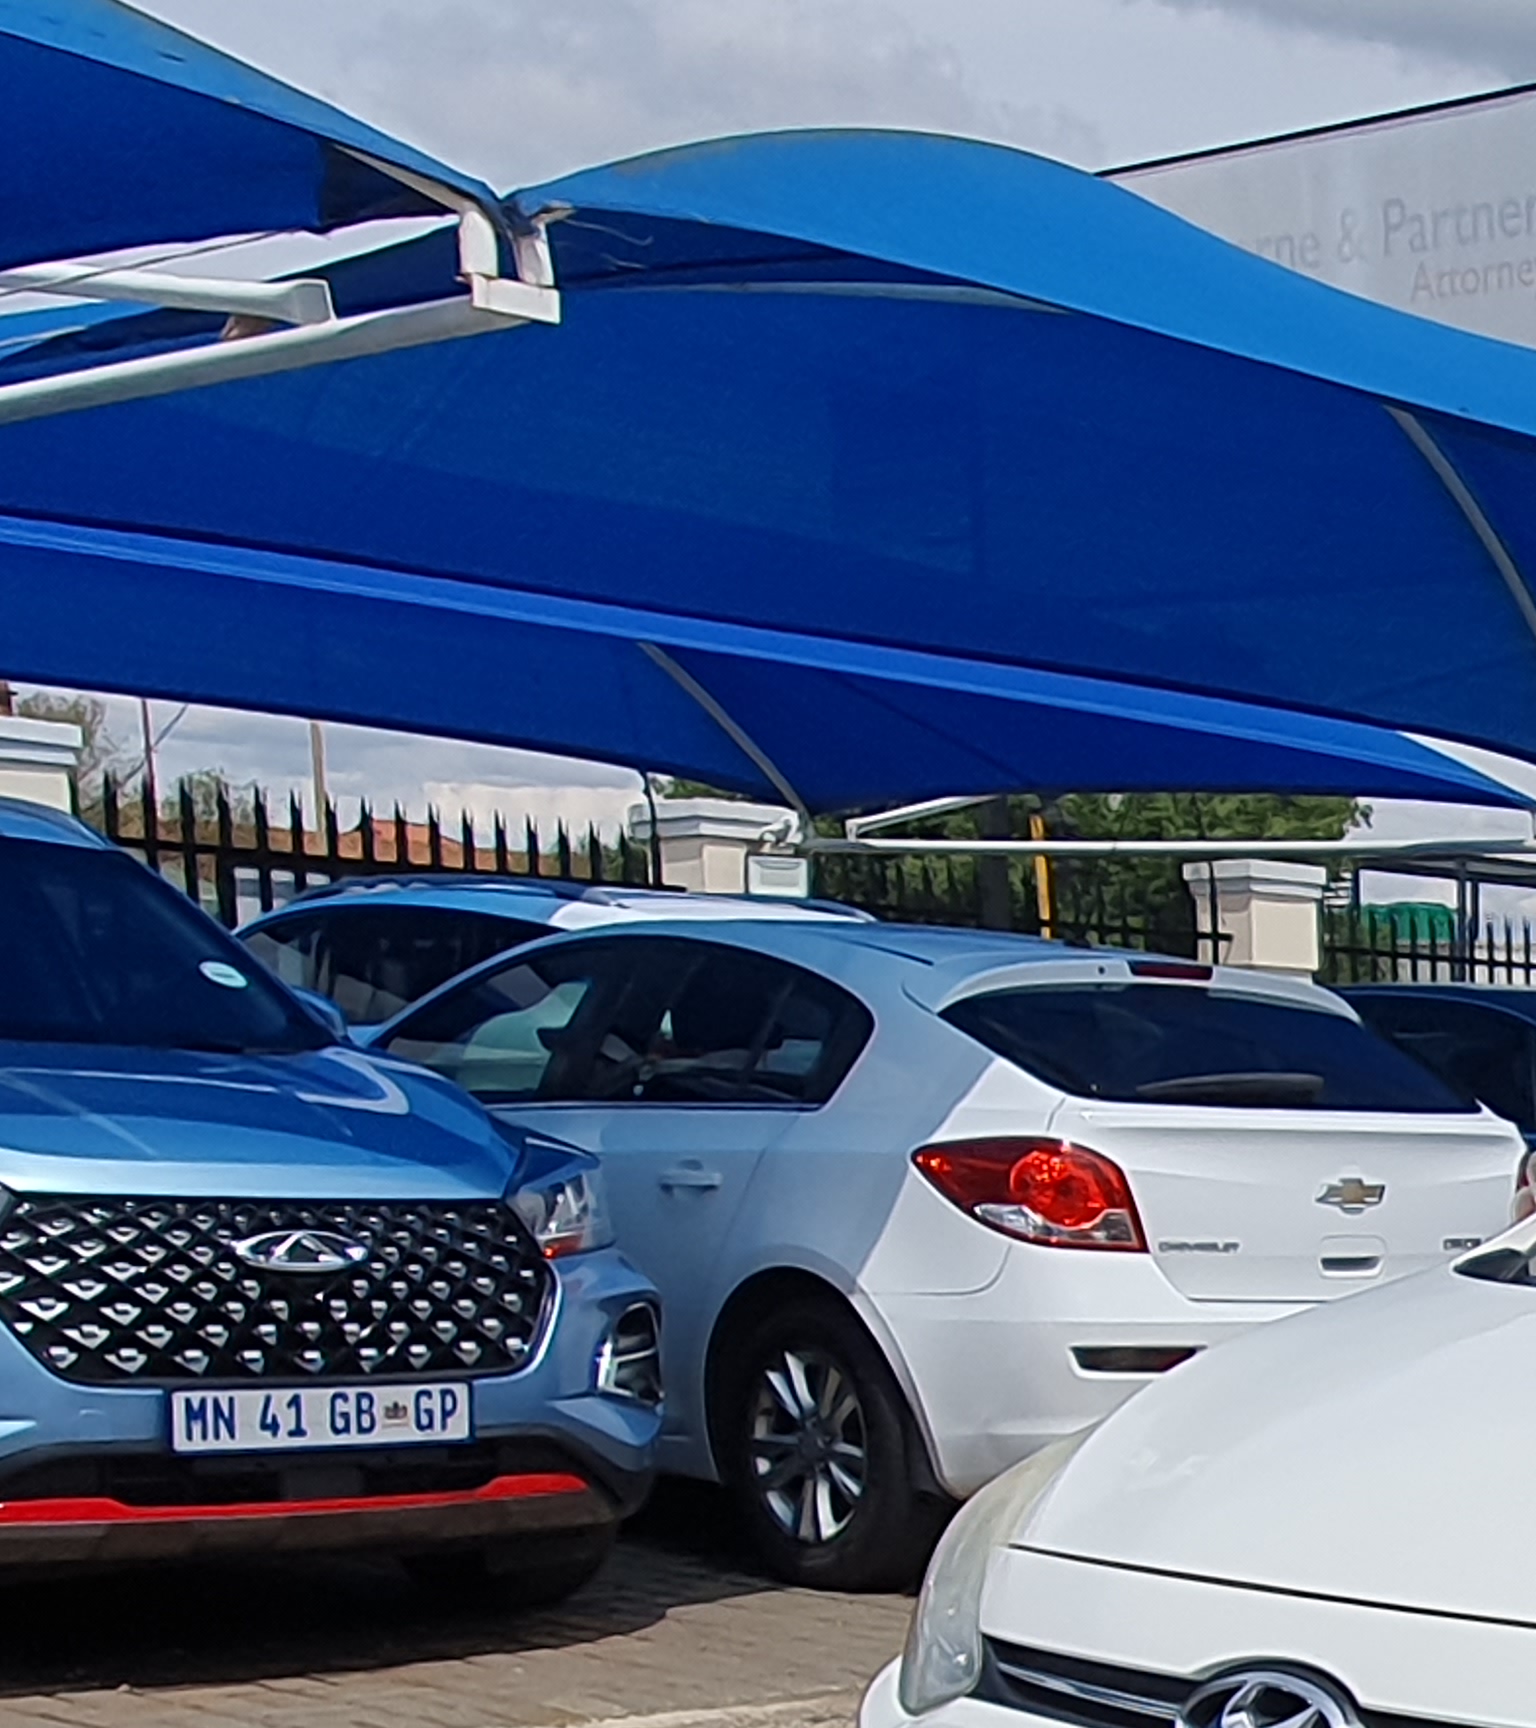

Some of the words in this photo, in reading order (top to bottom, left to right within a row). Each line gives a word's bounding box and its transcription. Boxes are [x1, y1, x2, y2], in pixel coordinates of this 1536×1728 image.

[1240, 232, 1321, 269] rne
[1337, 208, 1367, 264] &
[184, 1395, 236, 1442] MN
[259, 1393, 307, 1438] 41
[329, 1391, 376, 1436] GB
[413, 1387, 458, 1433] GP
